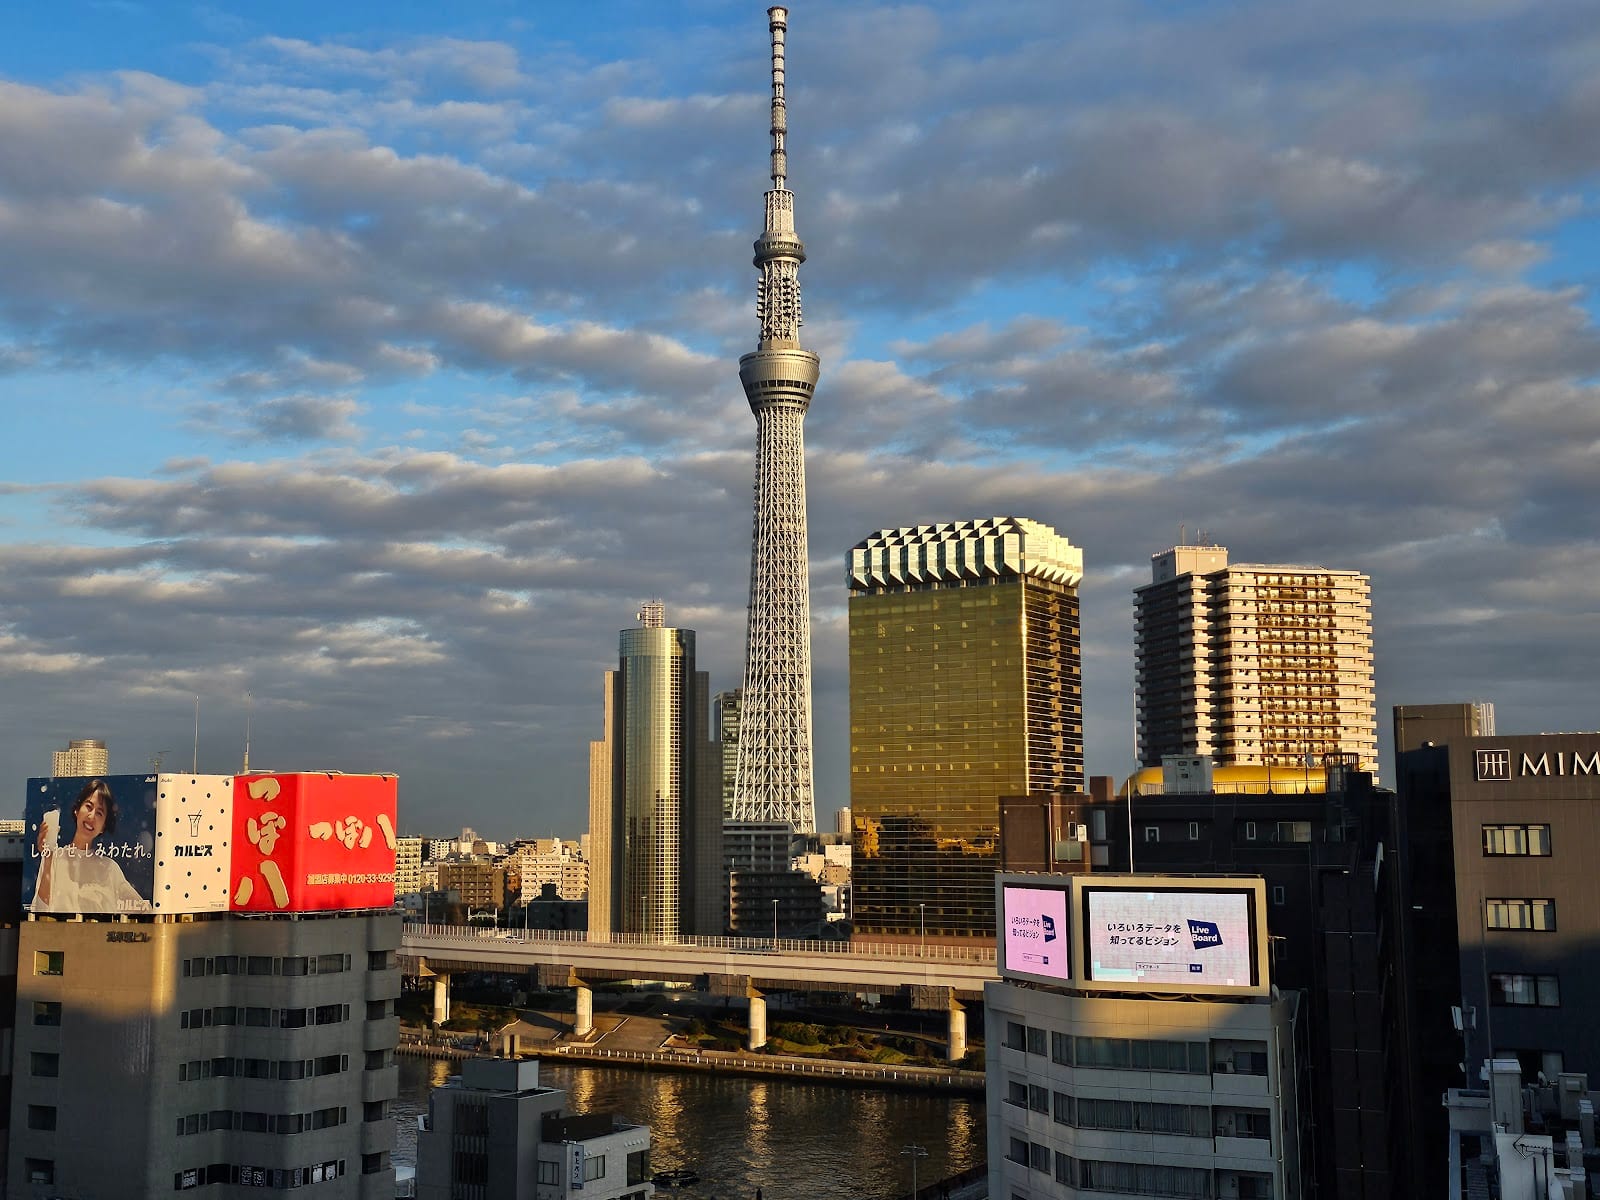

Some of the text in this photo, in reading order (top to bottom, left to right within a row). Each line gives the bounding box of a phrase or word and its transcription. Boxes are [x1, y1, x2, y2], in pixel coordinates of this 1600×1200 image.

[309, 813, 396, 850] つぼ八
[234, 777, 290, 909] つぼ八
[31, 842, 152, 859] しあわせ、しみわたれ。
[174, 844, 213, 857] カルピス
[1107, 923, 1181, 933] いろいろデータを
[1191, 926, 1210, 934] Live
[1109, 935, 1179, 946] 知ってるビジョン
[1192, 934, 1218, 942] Board
